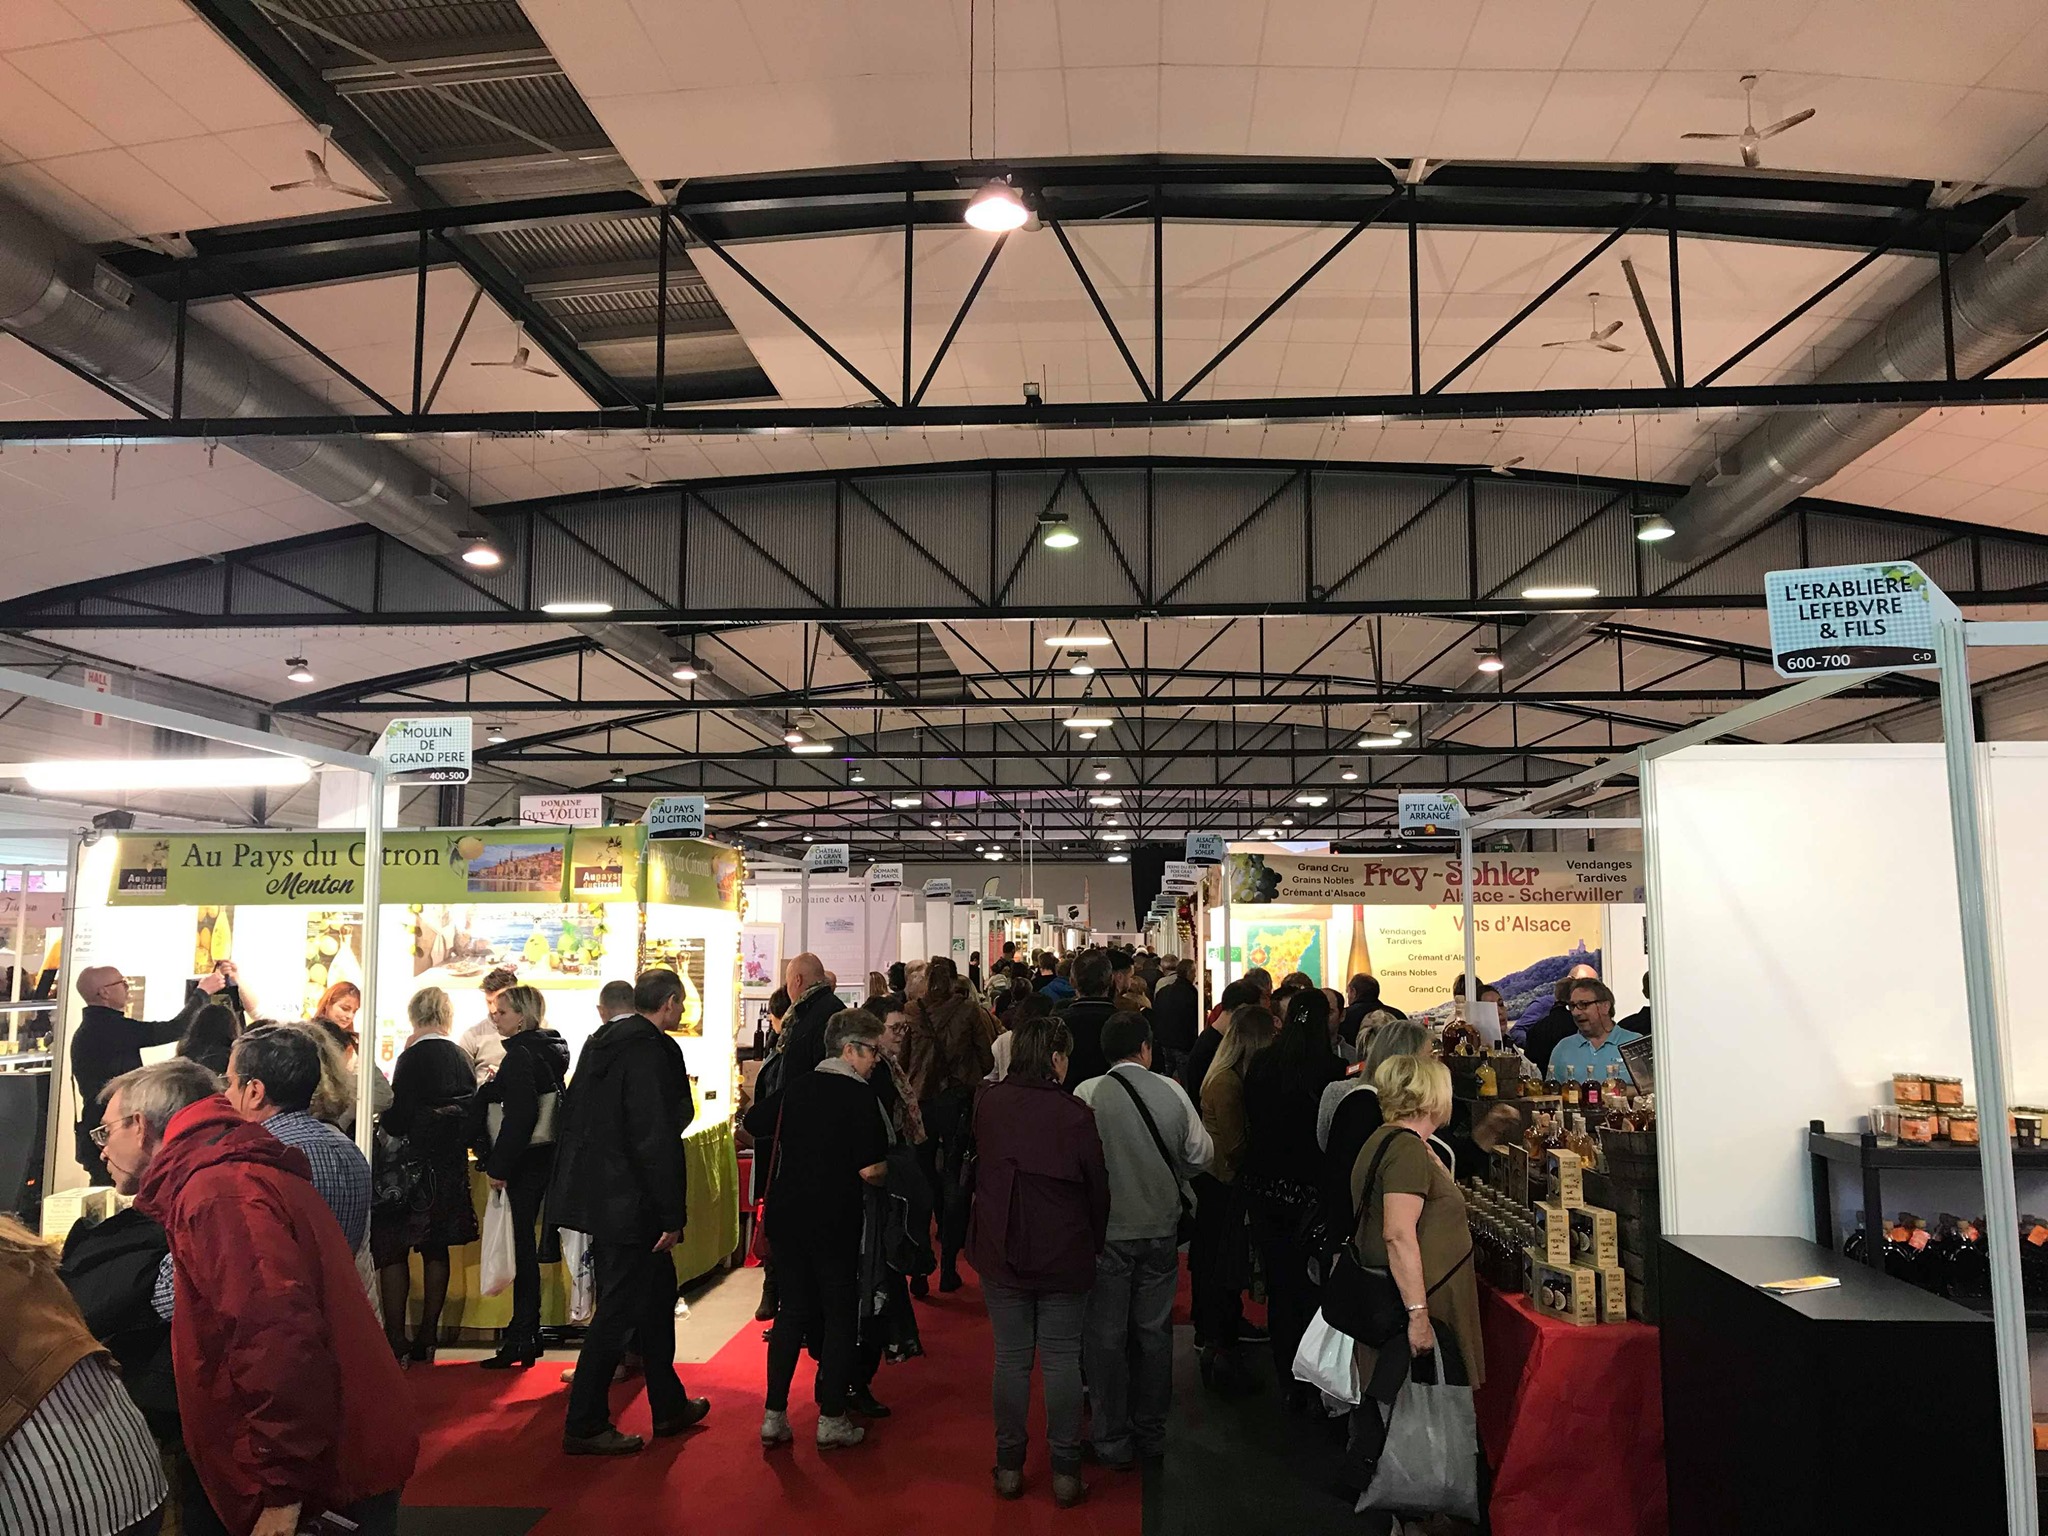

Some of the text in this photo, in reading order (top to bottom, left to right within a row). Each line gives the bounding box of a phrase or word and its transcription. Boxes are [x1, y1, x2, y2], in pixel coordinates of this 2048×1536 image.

[1785, 576, 1912, 601] L'ERABLIERE
[1799, 597, 1903, 621] LEFEBVRE
[1819, 619, 1887, 639] & FILS
[1786, 652, 1932, 670] 600-700 C-D
[88, 671, 107, 686] HALL
[403, 727, 452, 738] MOULIN
[420, 740, 435, 750] DE
[390, 752, 465, 764] GRAND PERE
[430, 772, 465, 780] 400-500
[541, 799, 582, 807] DOMAINE
[1405, 803, 1454, 812] P'TIT CALVA
[550, 808, 600, 819] VOLUET
[658, 805, 695, 813] AU PAYS
[652, 814, 701, 824] DU CITRON
[181, 839, 440, 875] Au Pays du Ctron
[1297, 863, 1349, 873] Grand Cru
[1566, 860, 1633, 871] Vendanges
[1292, 876, 1355, 885] Grains Nobles
[1576, 873, 1627, 883] Tardives
[266, 871, 355, 900] Menton
[833, 894, 845, 903] de
[848, 893, 888, 903] MAOL
[1282, 888, 1366, 898] Crémant d'Alsace
[1442, 888, 1504, 903] Alace
[1519, 887, 1623, 902] Scherwiller
[1453, 915, 1571, 932] Vns d'Alsace
[1379, 928, 1427, 937] Vendanges
[1408, 953, 1443, 961] Crémant
[1380, 969, 1437, 977] Grains Nobles
[1408, 985, 1434, 993] Grand
